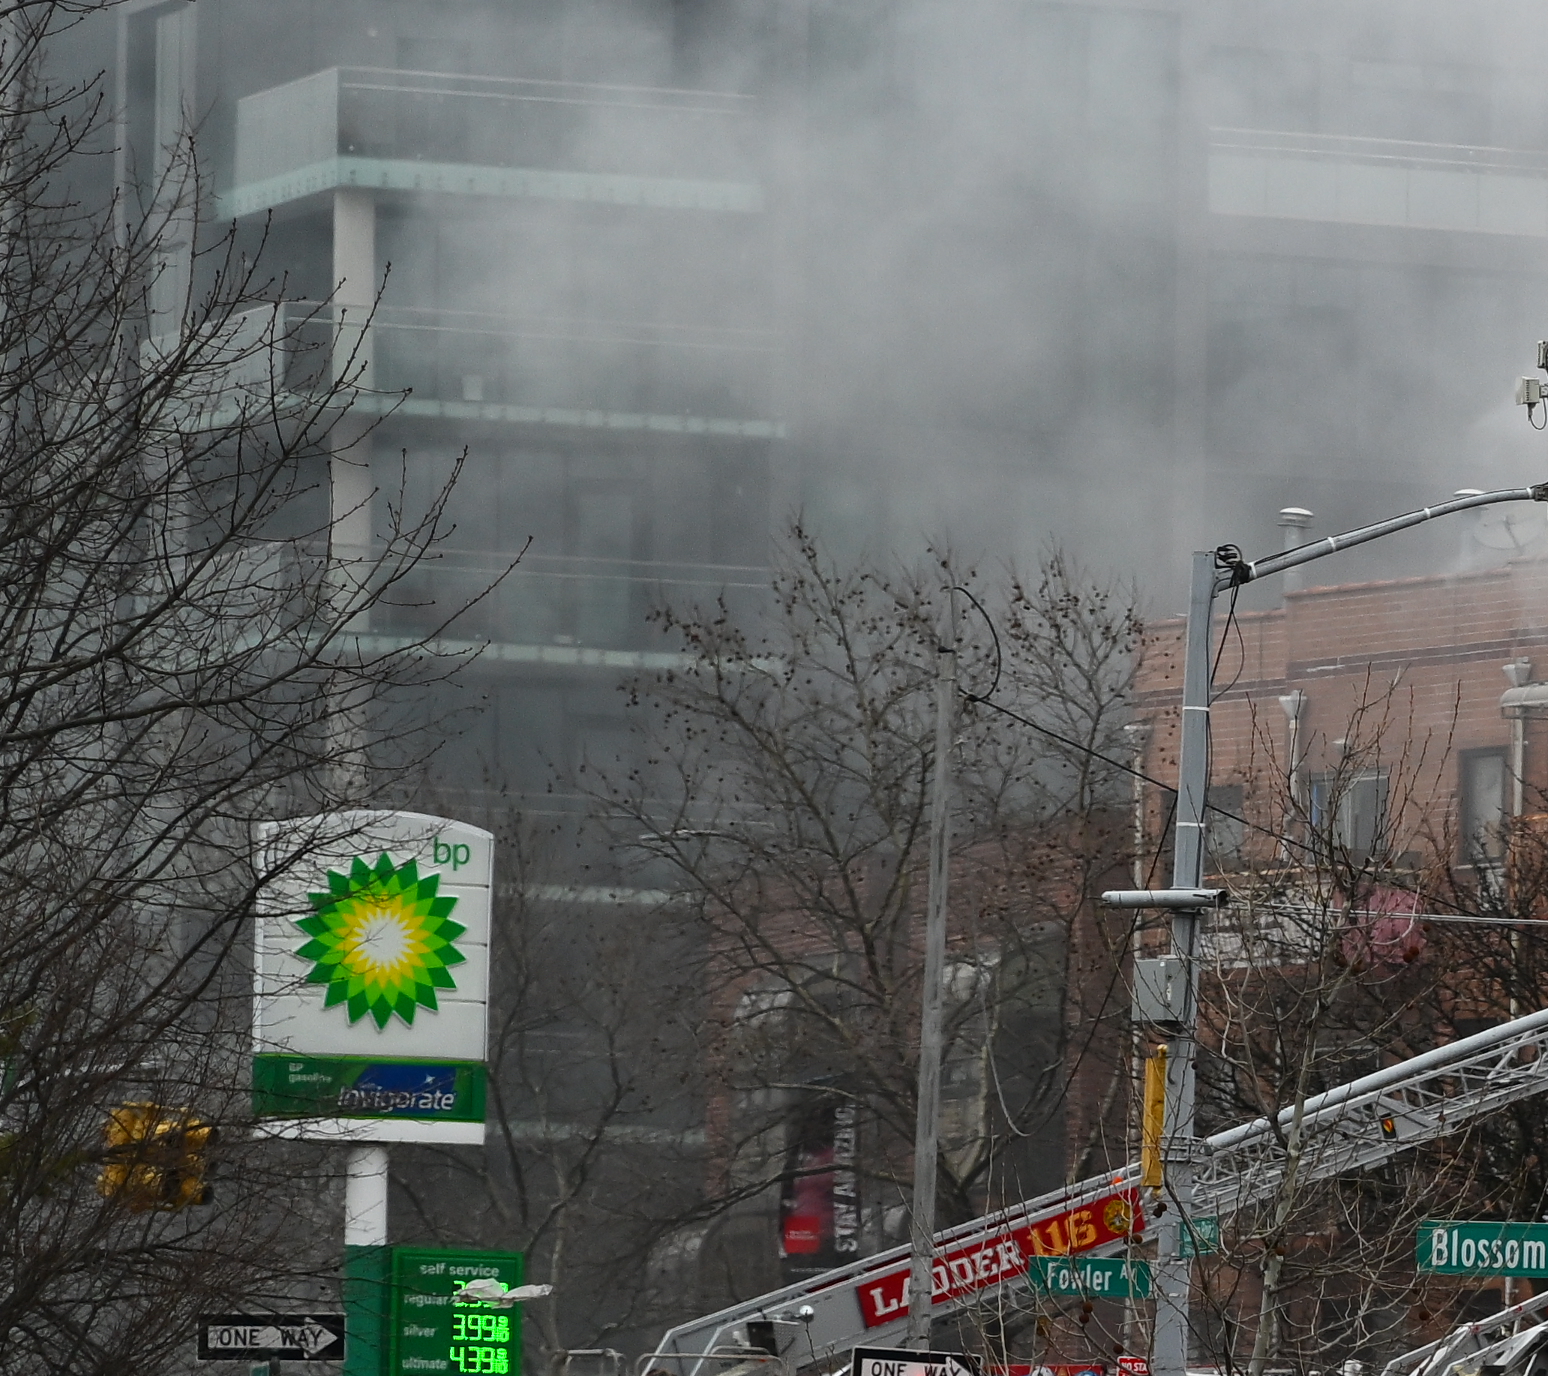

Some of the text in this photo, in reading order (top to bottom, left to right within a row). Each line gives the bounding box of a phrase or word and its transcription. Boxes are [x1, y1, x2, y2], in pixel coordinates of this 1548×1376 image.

[433, 836, 471, 872] bp
[1431, 1228, 1547, 1271] Blossom
[419, 1262, 500, 1278] self service
[1046, 1260, 1113, 1292] Fowler
[219, 1328, 323, 1347] ONE WAY
